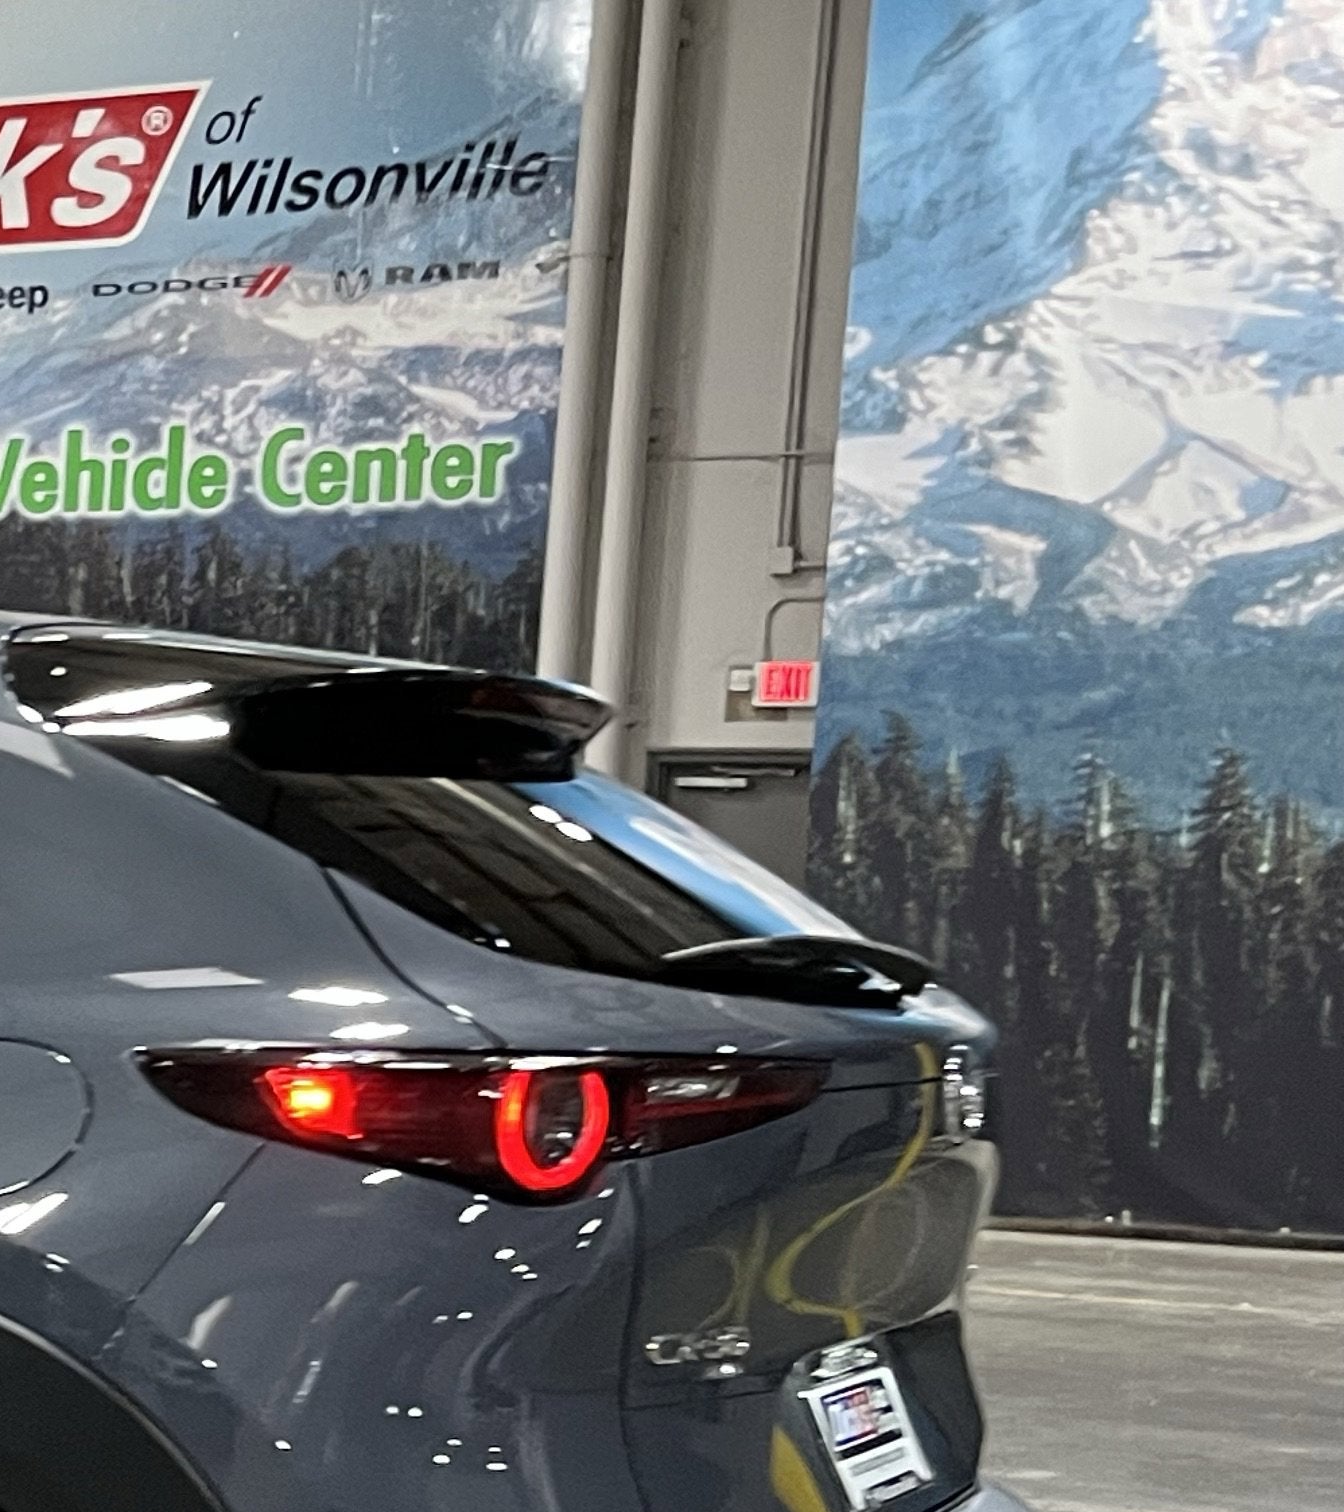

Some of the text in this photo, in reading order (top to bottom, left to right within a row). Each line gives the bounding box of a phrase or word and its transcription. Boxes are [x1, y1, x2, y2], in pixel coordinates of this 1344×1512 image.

[205, 95, 264, 146] of
[187, 131, 551, 220] Wilsonville
[91, 274, 263, 298] DODGE
[384, 259, 501, 286] RAM
[260, 427, 513, 508] Center
[765, 665, 811, 699] EXIT
